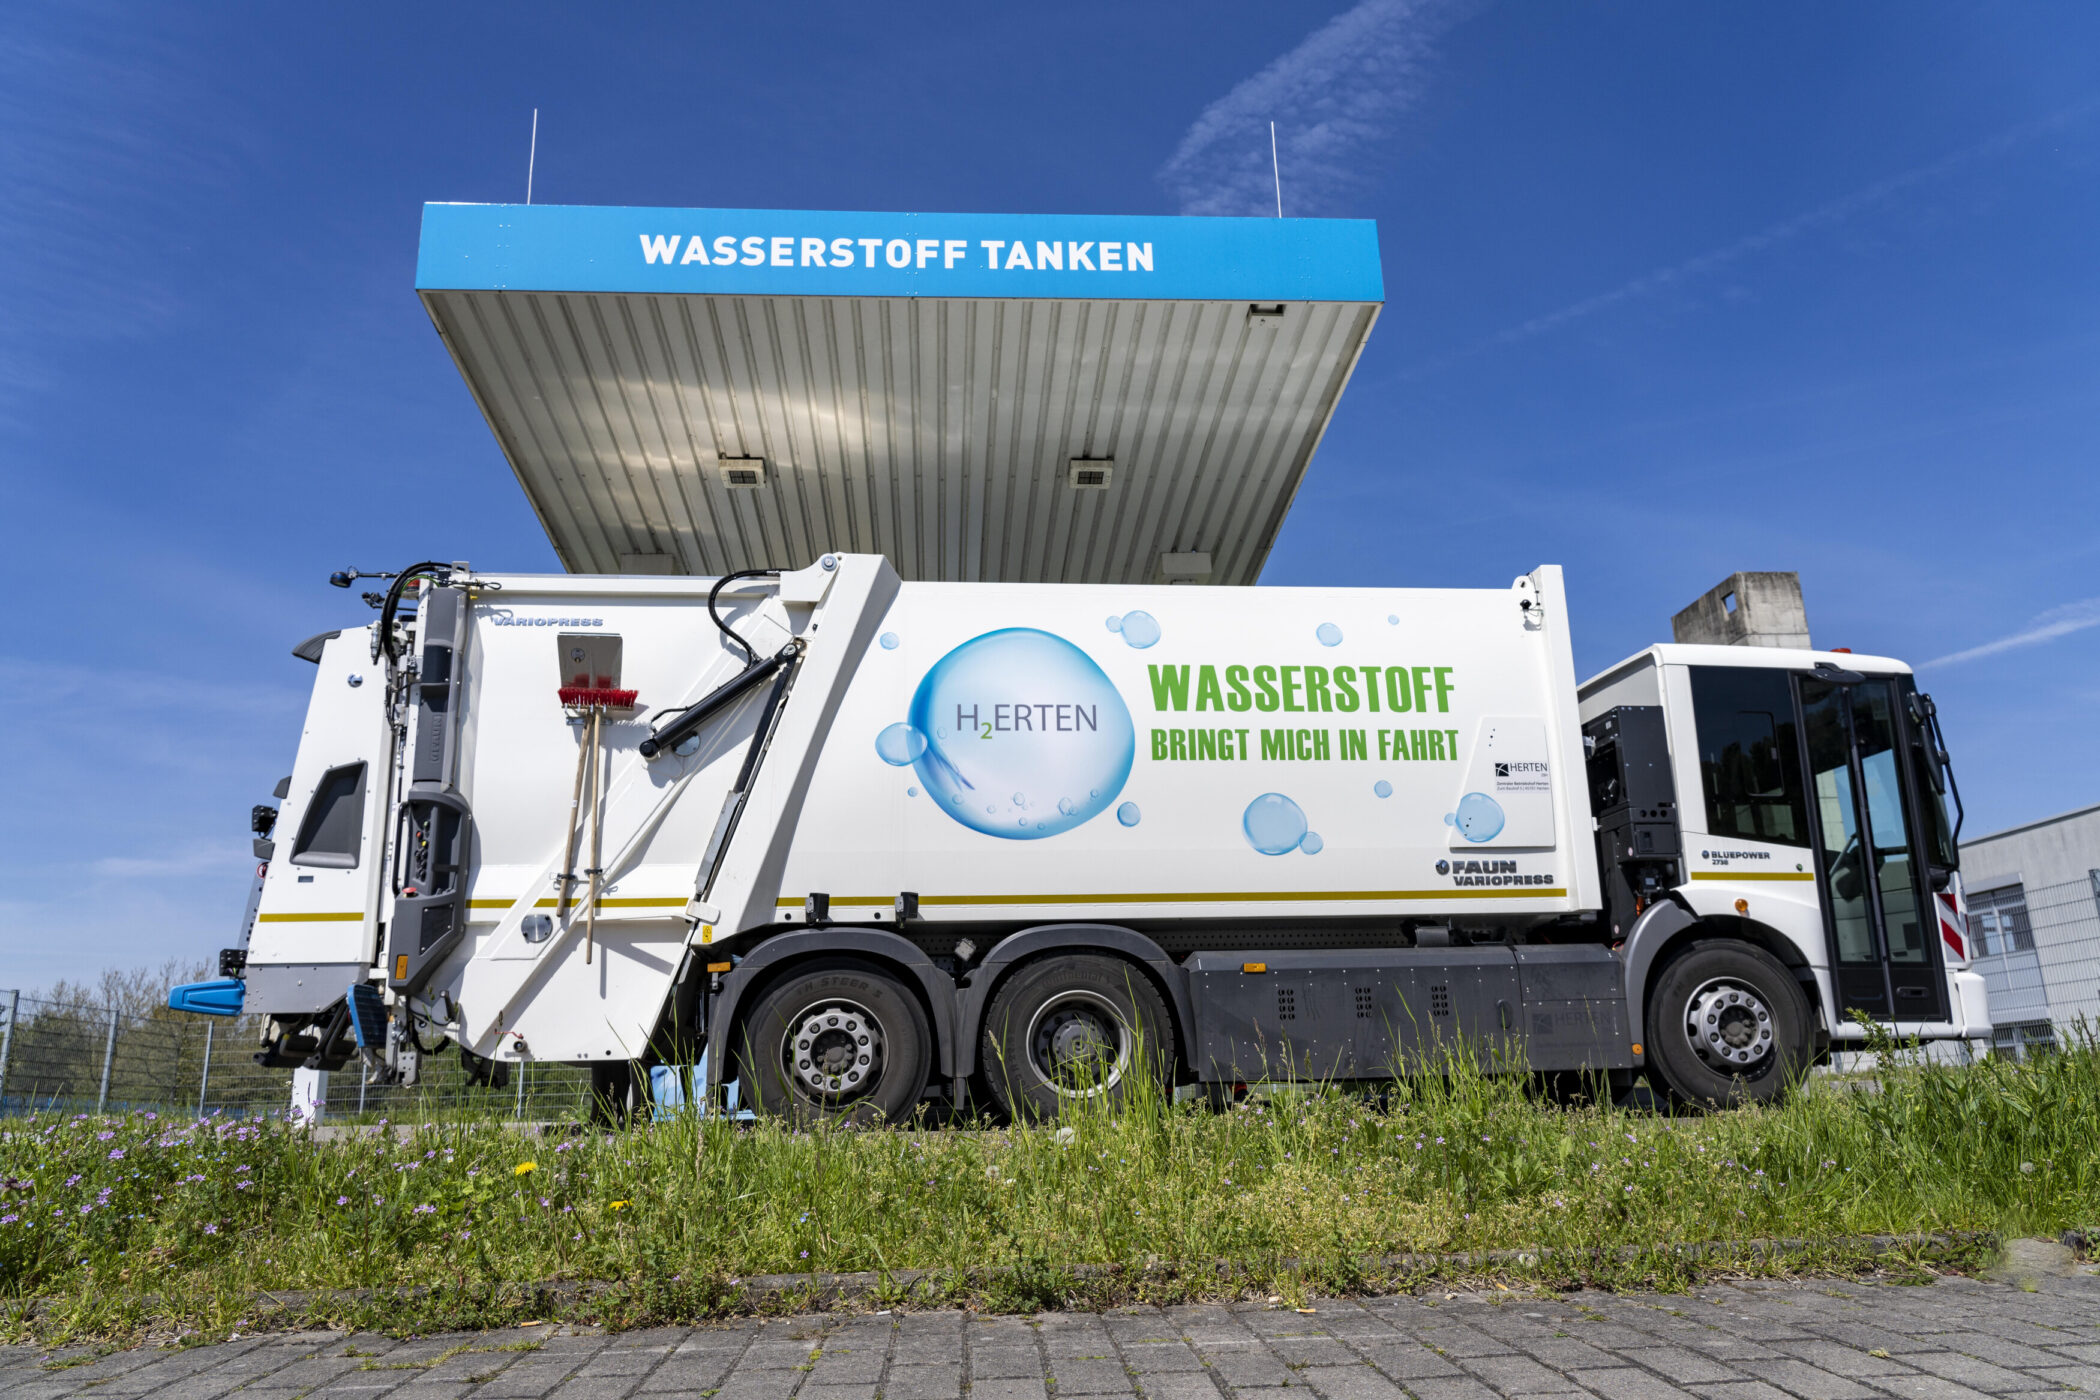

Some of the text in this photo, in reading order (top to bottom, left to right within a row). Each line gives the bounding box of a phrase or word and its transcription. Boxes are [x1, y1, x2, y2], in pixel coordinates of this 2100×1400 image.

[639, 234, 1155, 272] WASSERSTOFF TANKEN
[493, 617, 604, 627] VARIOPRESS
[1147, 664, 1455, 713] WASSERSTOFF
[1151, 728, 1458, 761] BRINGT MICH IN FAHRT
[1510, 762, 1548, 772] HERTEN
[1711, 851, 1771, 859] BLUEPOWER
[1452, 860, 1517, 874] FAUN
[1454, 874, 1554, 887] VARIOPRESS
